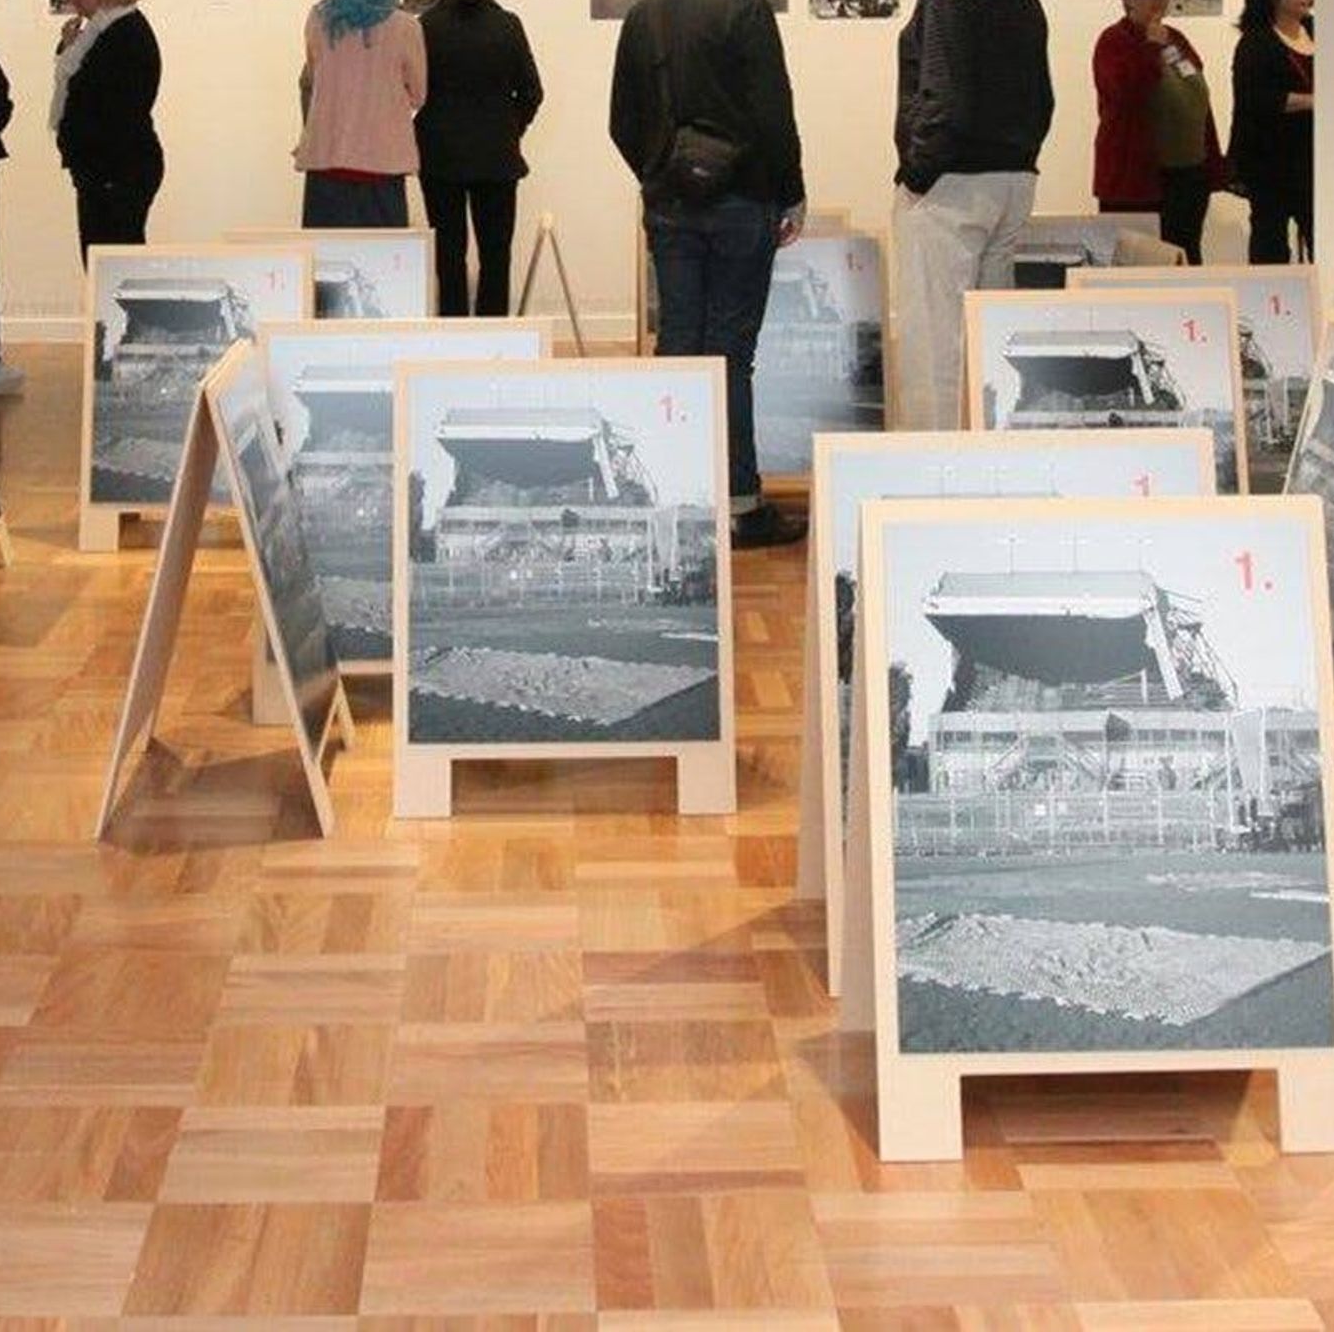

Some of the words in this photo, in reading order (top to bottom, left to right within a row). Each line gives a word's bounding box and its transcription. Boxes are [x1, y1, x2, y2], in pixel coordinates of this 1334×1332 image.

[1182, 319, 1207, 342] 1.
[658, 394, 687, 423] 1.
[1234, 549, 1275, 591] 1.
